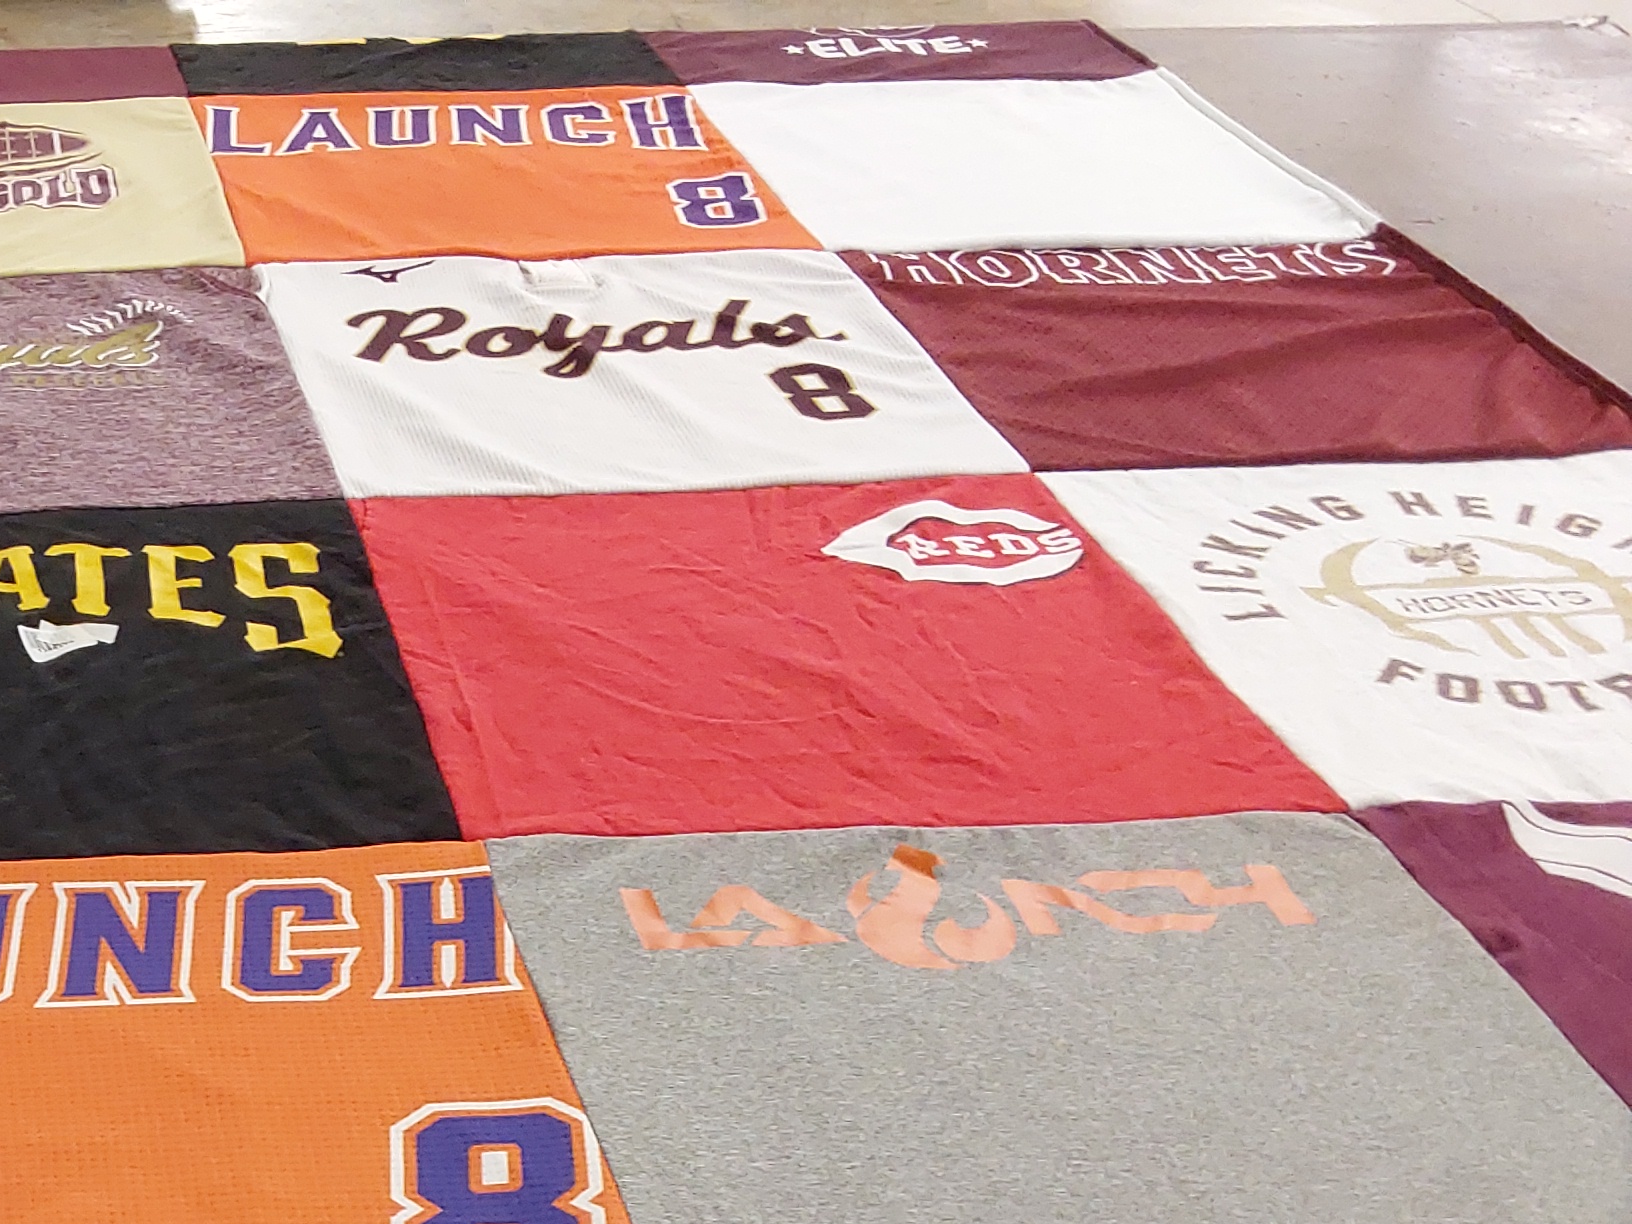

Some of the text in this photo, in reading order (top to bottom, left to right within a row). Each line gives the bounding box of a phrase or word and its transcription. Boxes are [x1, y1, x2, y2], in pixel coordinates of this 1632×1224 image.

[805, 35, 973, 59] ELITE
[205, 94, 708, 157] LAUNCH
[668, 171, 768, 229] 8
[868, 238, 1398, 288] HORNETS
[346, 300, 846, 378] Royals
[766, 362, 878, 420] 8
[895, 528, 1083, 560] REDS
[1193, 495, 1364, 624] LICKING
[1400, 590, 1594, 614] HORNETS
